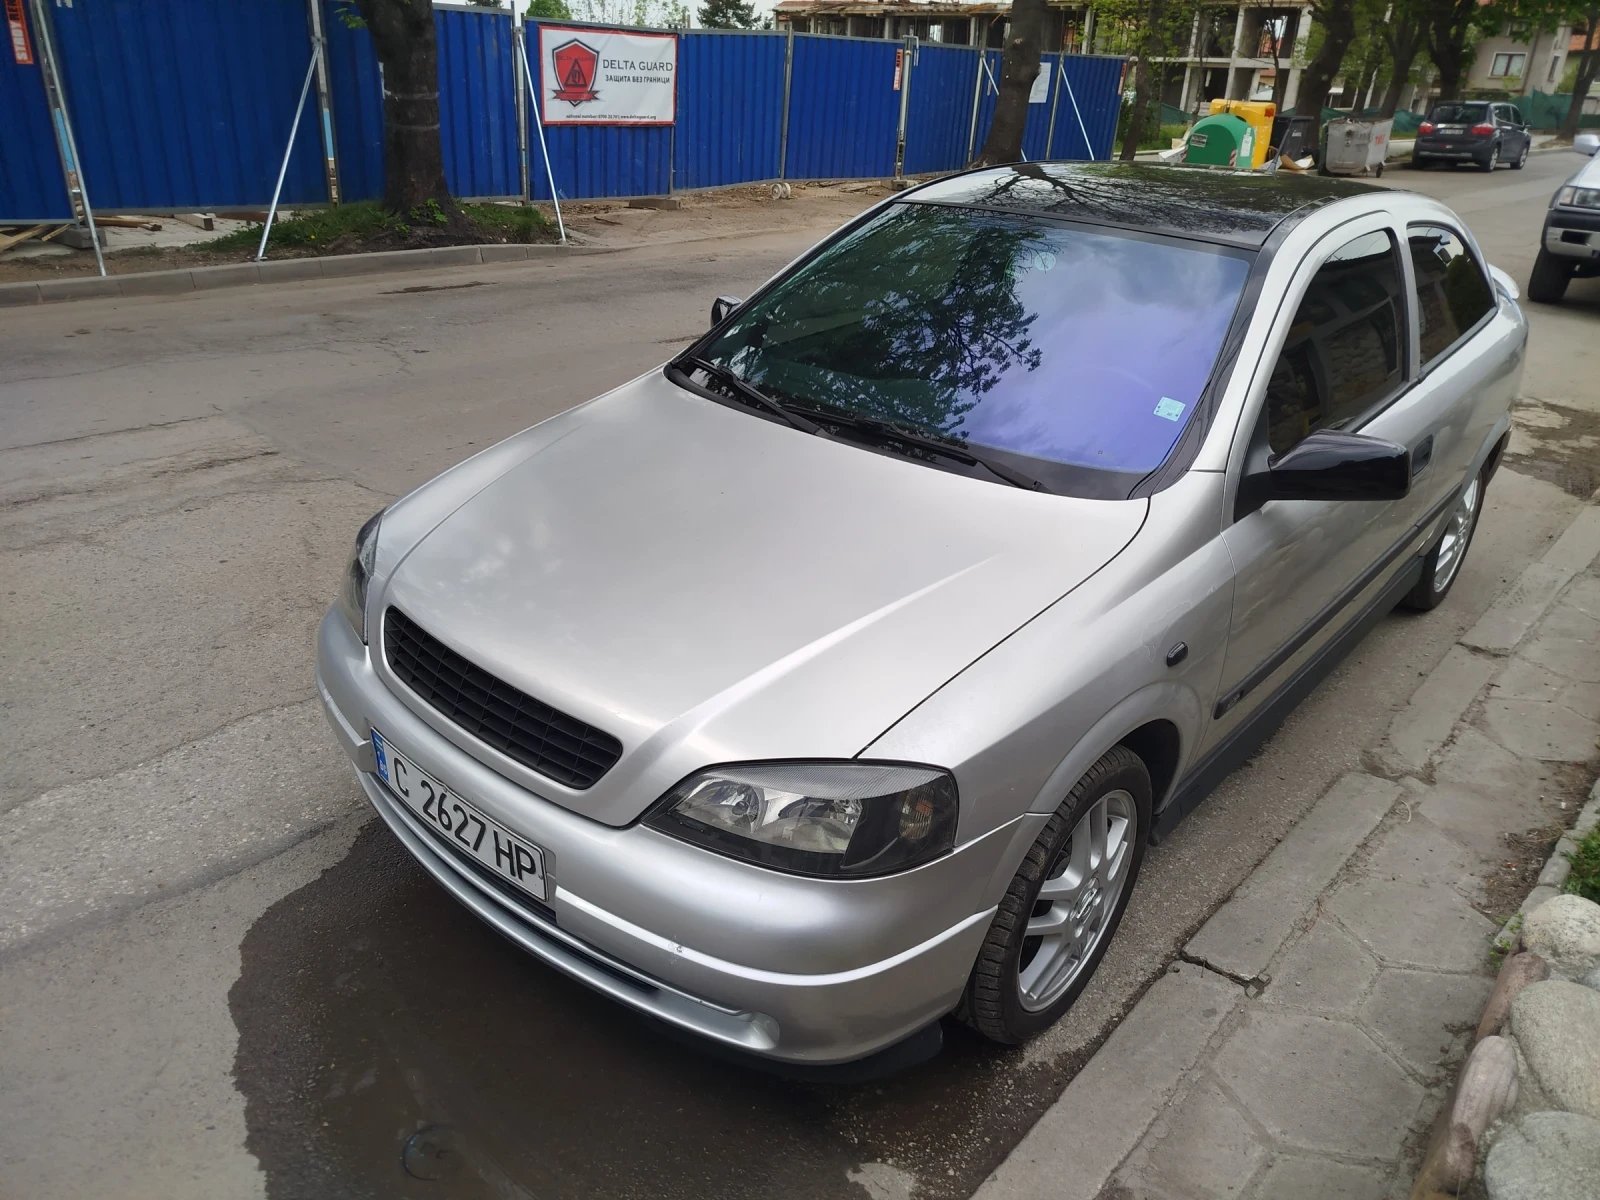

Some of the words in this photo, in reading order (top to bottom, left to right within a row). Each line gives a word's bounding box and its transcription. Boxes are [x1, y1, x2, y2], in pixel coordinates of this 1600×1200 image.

[602, 59, 636, 71] DELTA
[638, 61, 673, 72] GUARD
[605, 74, 631, 83] ЗАЩИТА
[632, 75, 643, 83] БЕЗ
[643, 76, 670, 84] ГРАНИЦИ
[393, 757, 409, 798] C
[420, 779, 487, 852] 2627
[493, 829, 537, 881] HP
